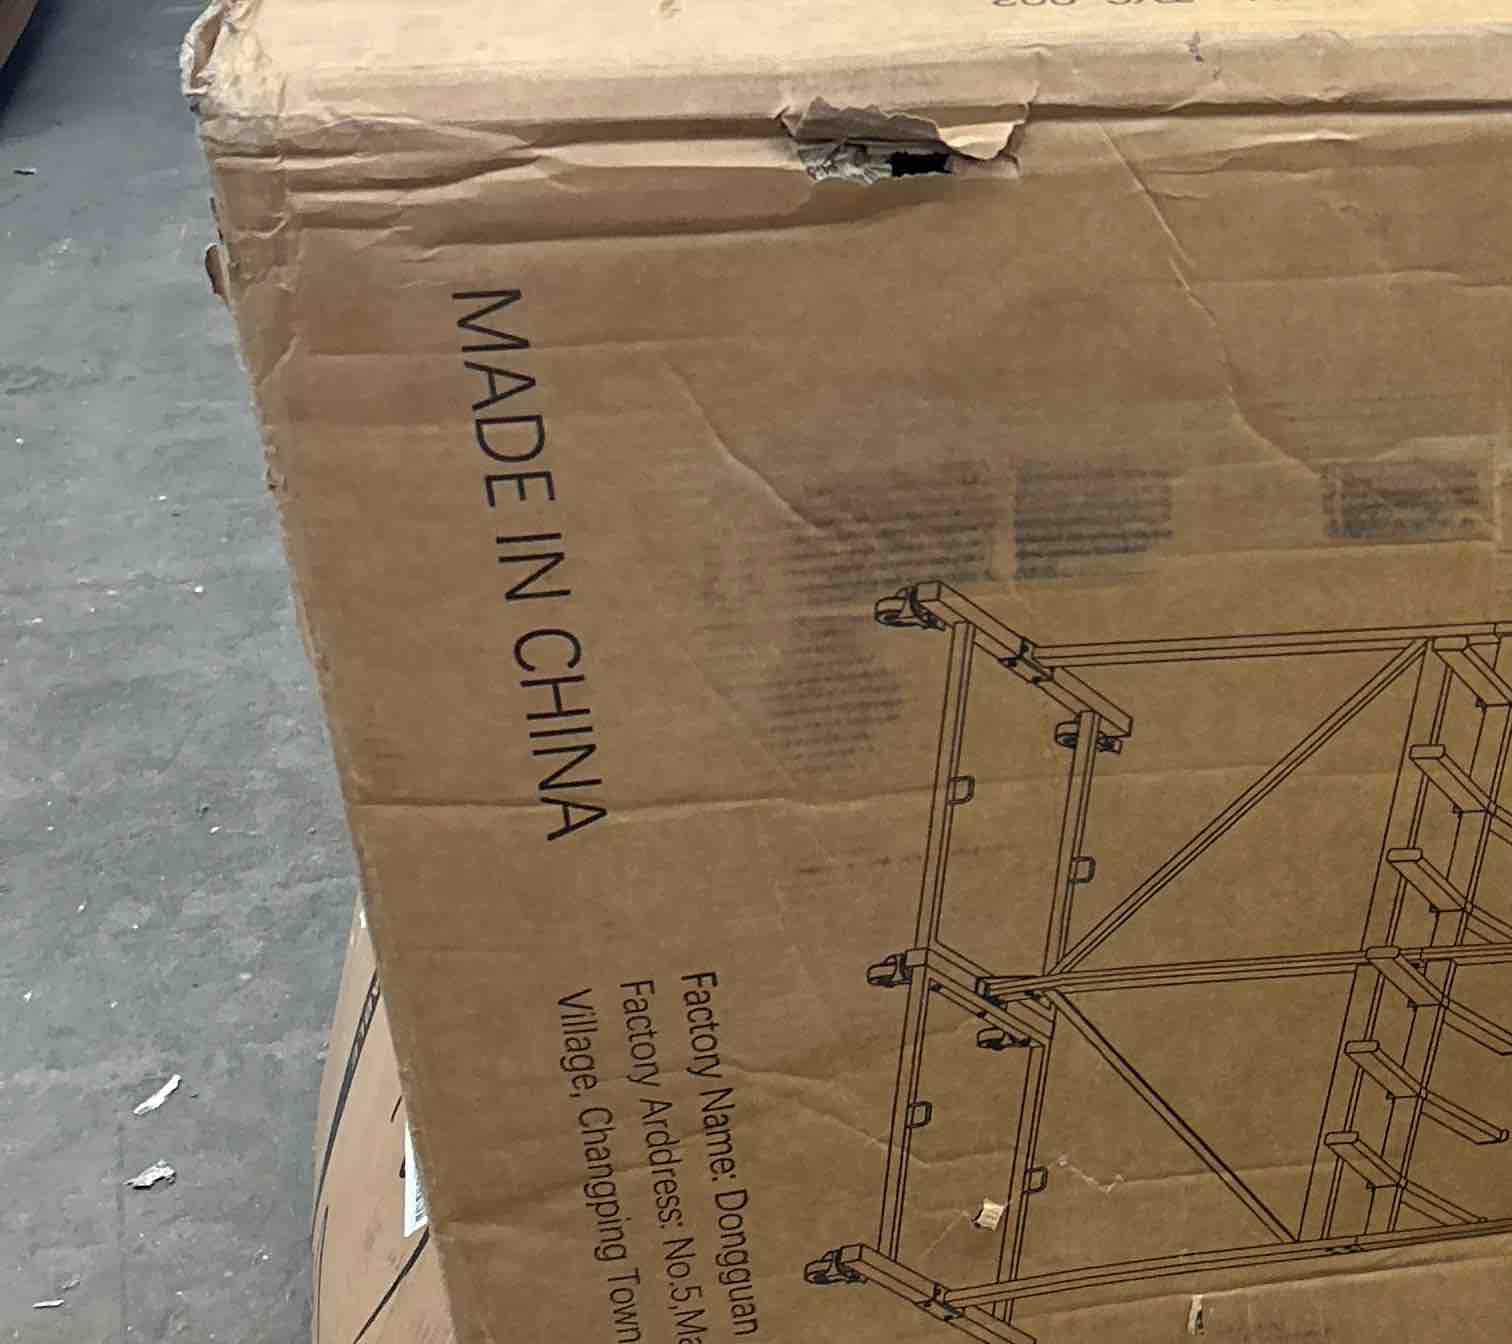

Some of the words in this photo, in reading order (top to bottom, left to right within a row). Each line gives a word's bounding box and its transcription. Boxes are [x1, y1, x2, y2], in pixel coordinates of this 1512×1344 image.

[452, 288, 556, 508] MADE
[496, 532, 572, 602] IN
[514, 628, 609, 841] CHINA
[557, 988, 600, 1098] Village,
[681, 972, 723, 1079] Factory
[619, 980, 661, 1087] Factory
[640, 1098, 684, 1230] Arddress:
[699, 1087, 737, 1182] Name:
[578, 1107, 632, 1262] Changping
[714, 1188, 758, 1336] Dongguan
